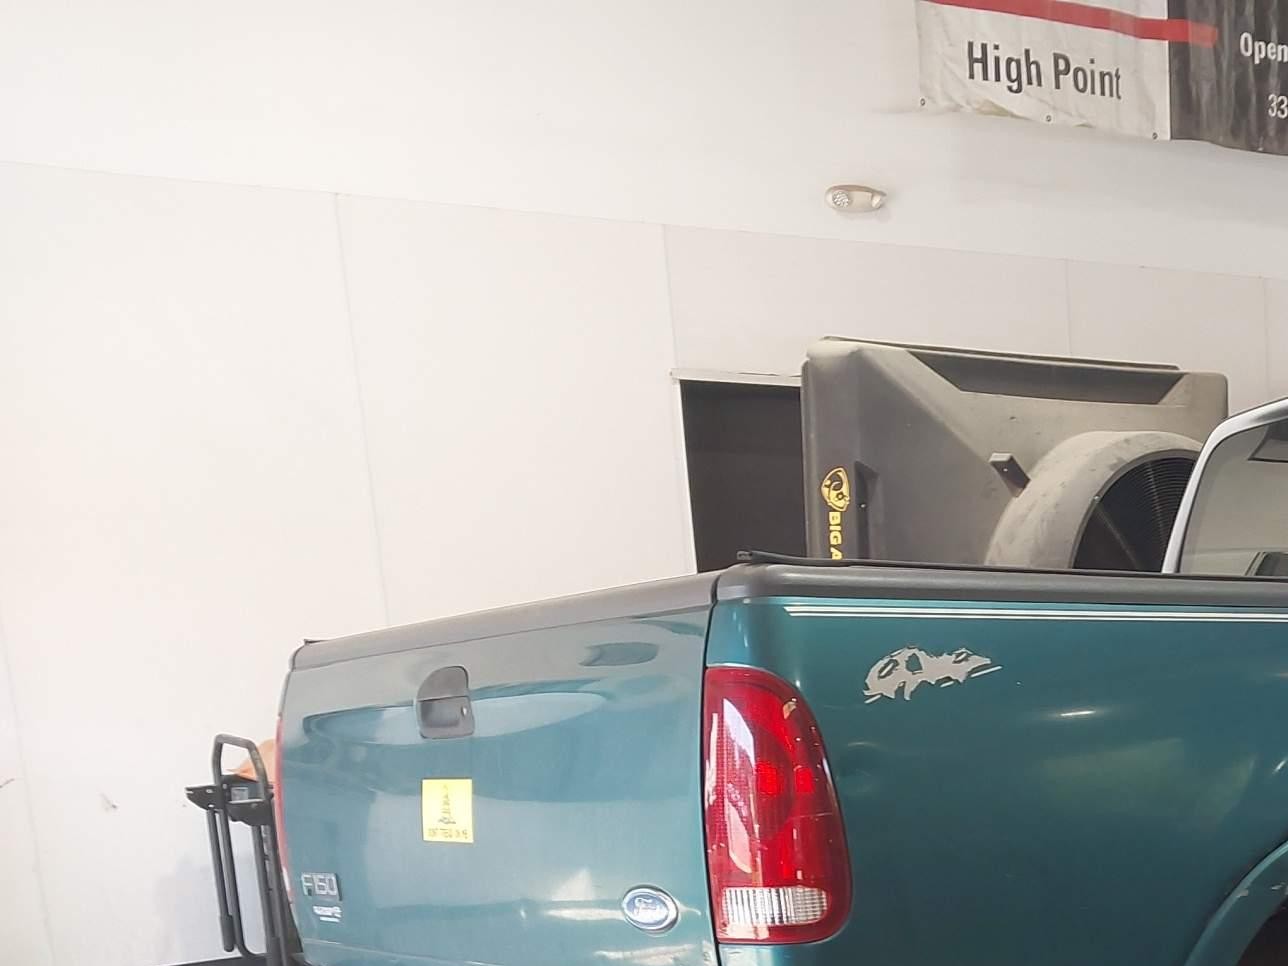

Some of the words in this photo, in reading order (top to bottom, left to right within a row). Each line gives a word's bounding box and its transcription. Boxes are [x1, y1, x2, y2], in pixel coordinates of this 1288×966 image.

[1239, 32, 1288, 64] Open
[967, 41, 1043, 94] High
[1052, 52, 1122, 100] Point
[828, 511, 842, 545] BIG
